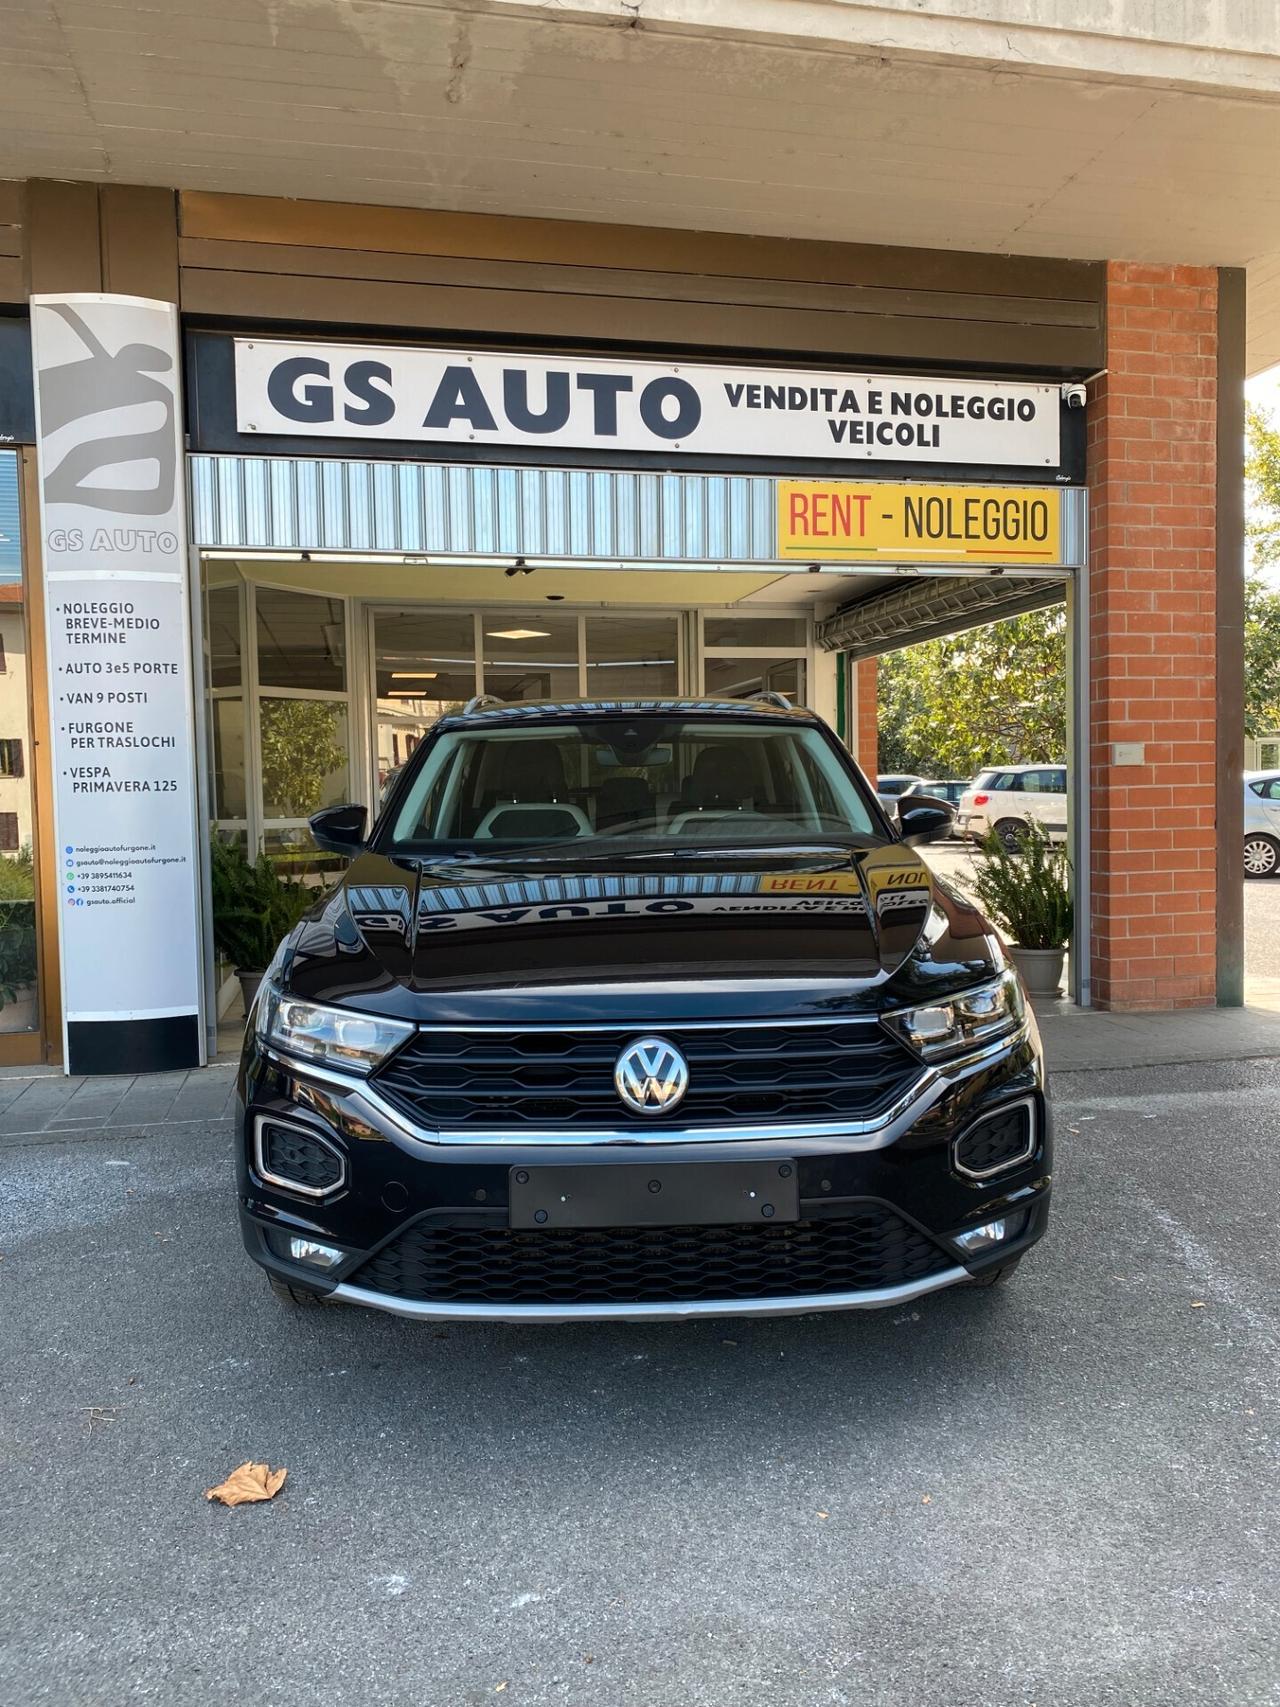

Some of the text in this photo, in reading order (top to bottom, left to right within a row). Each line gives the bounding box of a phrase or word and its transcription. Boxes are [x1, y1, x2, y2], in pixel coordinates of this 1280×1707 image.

[267, 356, 702, 440] GS AUTO
[723, 383, 1036, 422] VENDITA E NOLEGGIO
[827, 419, 940, 447] VEICOLI
[789, 493, 872, 537] RENT
[904, 496, 1048, 541] NOLEGGIO
[47, 528, 178, 554] GS AUTO
[63, 602, 134, 614] NOLEGGIO
[66, 618, 160, 630] BREVE-MEDIO
[66, 632, 127, 644] TERMINE
[65, 662, 102, 675] AUTO
[133, 663, 178, 675] PORTE
[67, 692, 148, 704] VAN 9 POSTI
[68, 721, 134, 734] FURGONE
[71, 736, 176, 749] PER TRASLOCHI
[70, 766, 111, 778] VESPA
[73, 780, 178, 793] PRIMAVERA 125
[75, 844, 156, 854] noleggioautofurgone.it
[77, 872, 90, 880] +39
[77, 885, 90, 893] +39
[86, 896, 136, 907] gsauto.official
